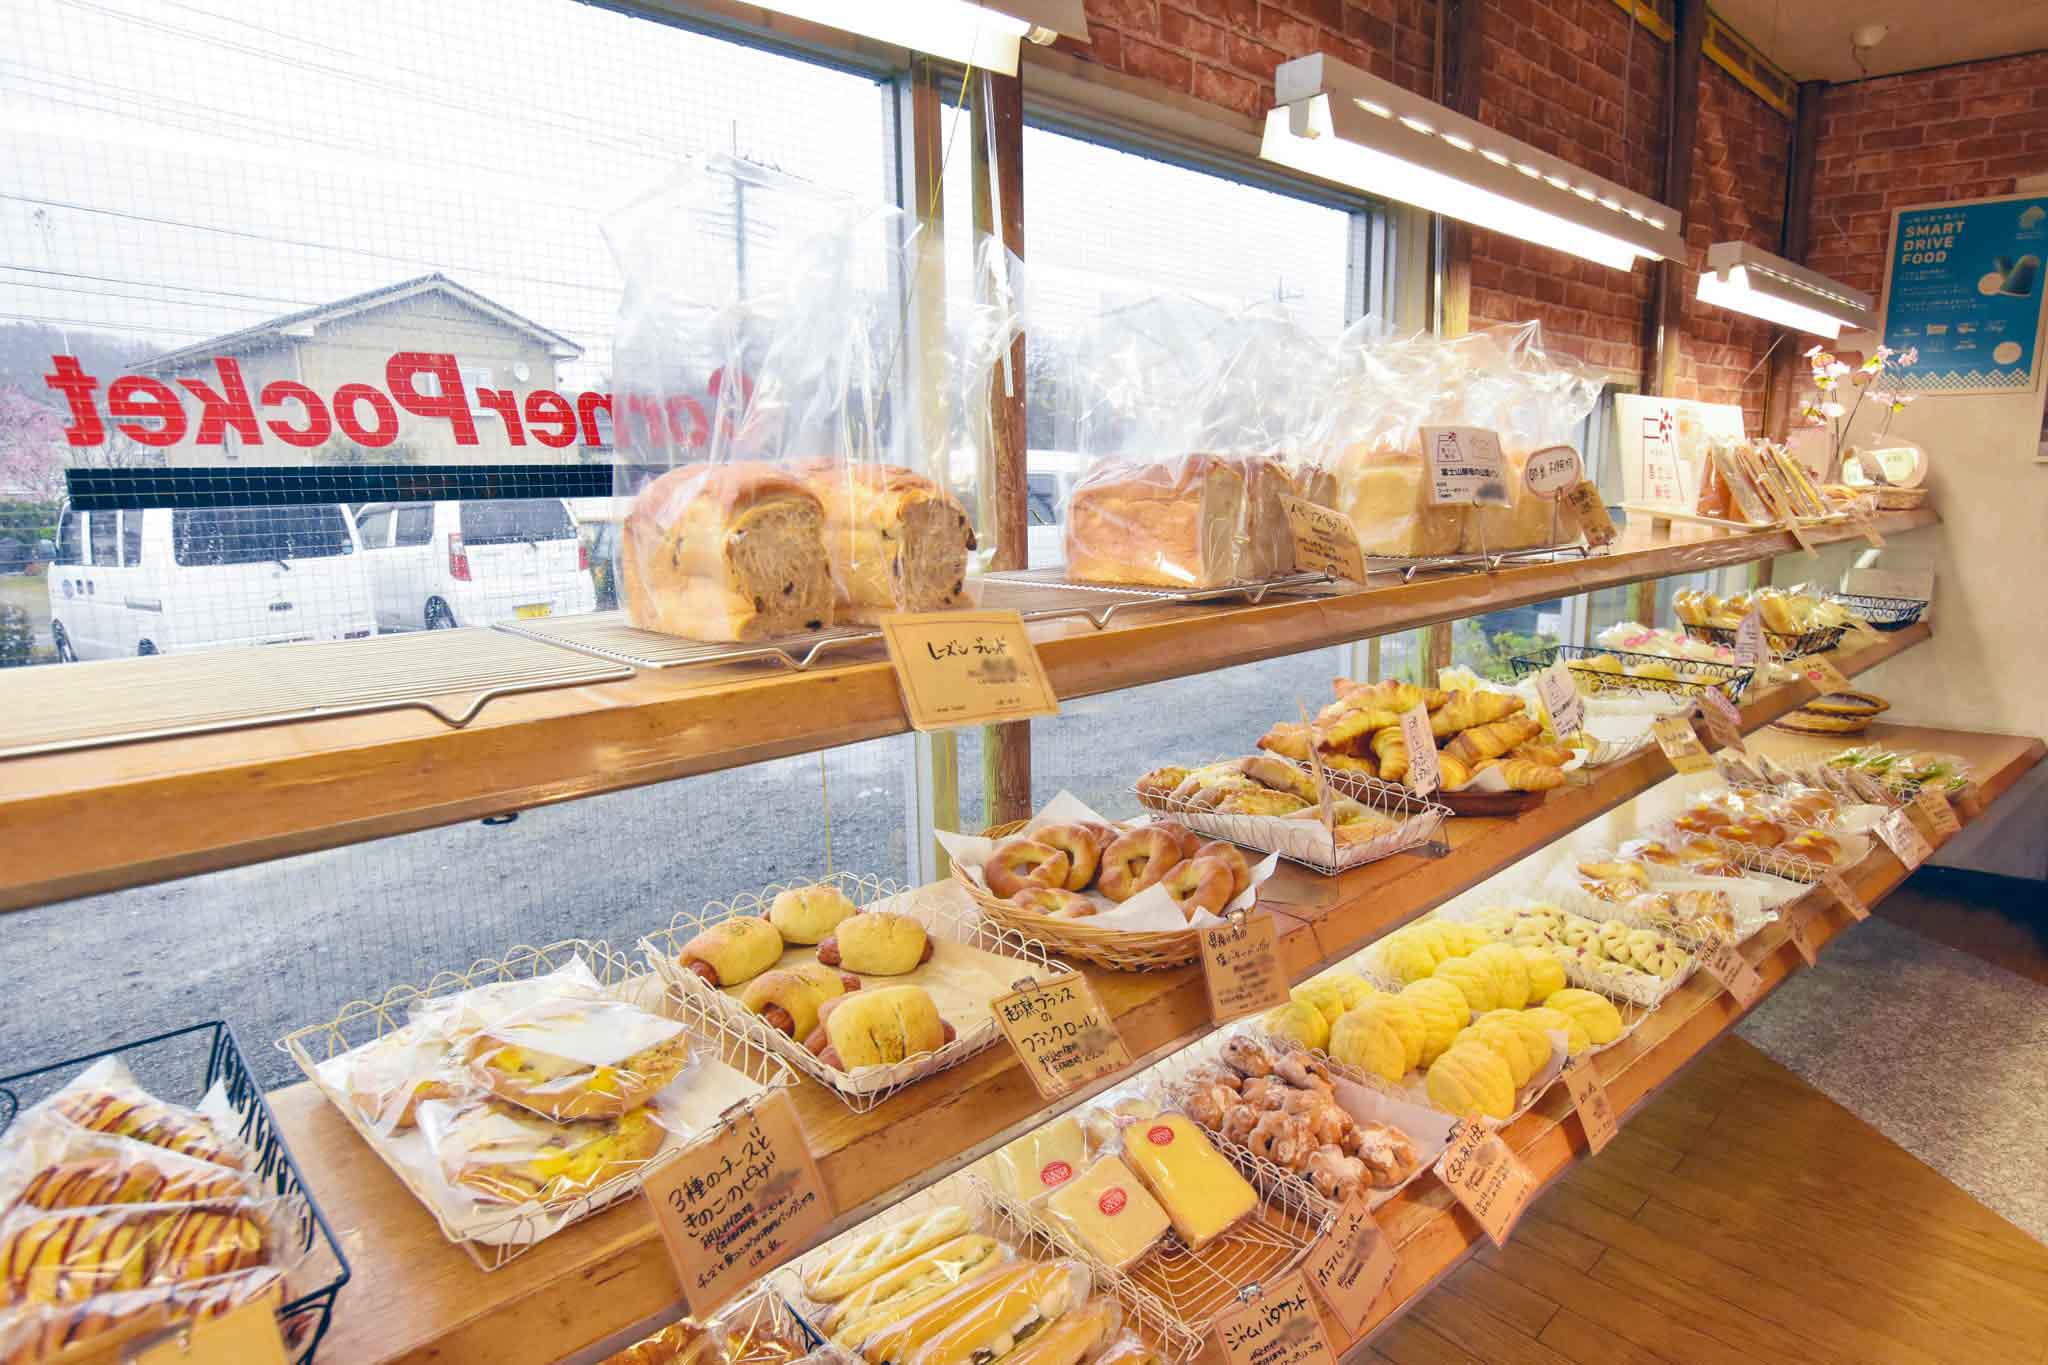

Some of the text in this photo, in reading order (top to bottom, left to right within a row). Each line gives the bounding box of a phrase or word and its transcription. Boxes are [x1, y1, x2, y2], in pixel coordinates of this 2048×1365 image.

[1905, 220, 1966, 238] SMART
[1903, 235, 1955, 252] DRIVE
[1901, 250, 1948, 265] FOOD
[1041, 1011, 1053, 1023] の
[1022, 1015, 1098, 1053] フランクロール
